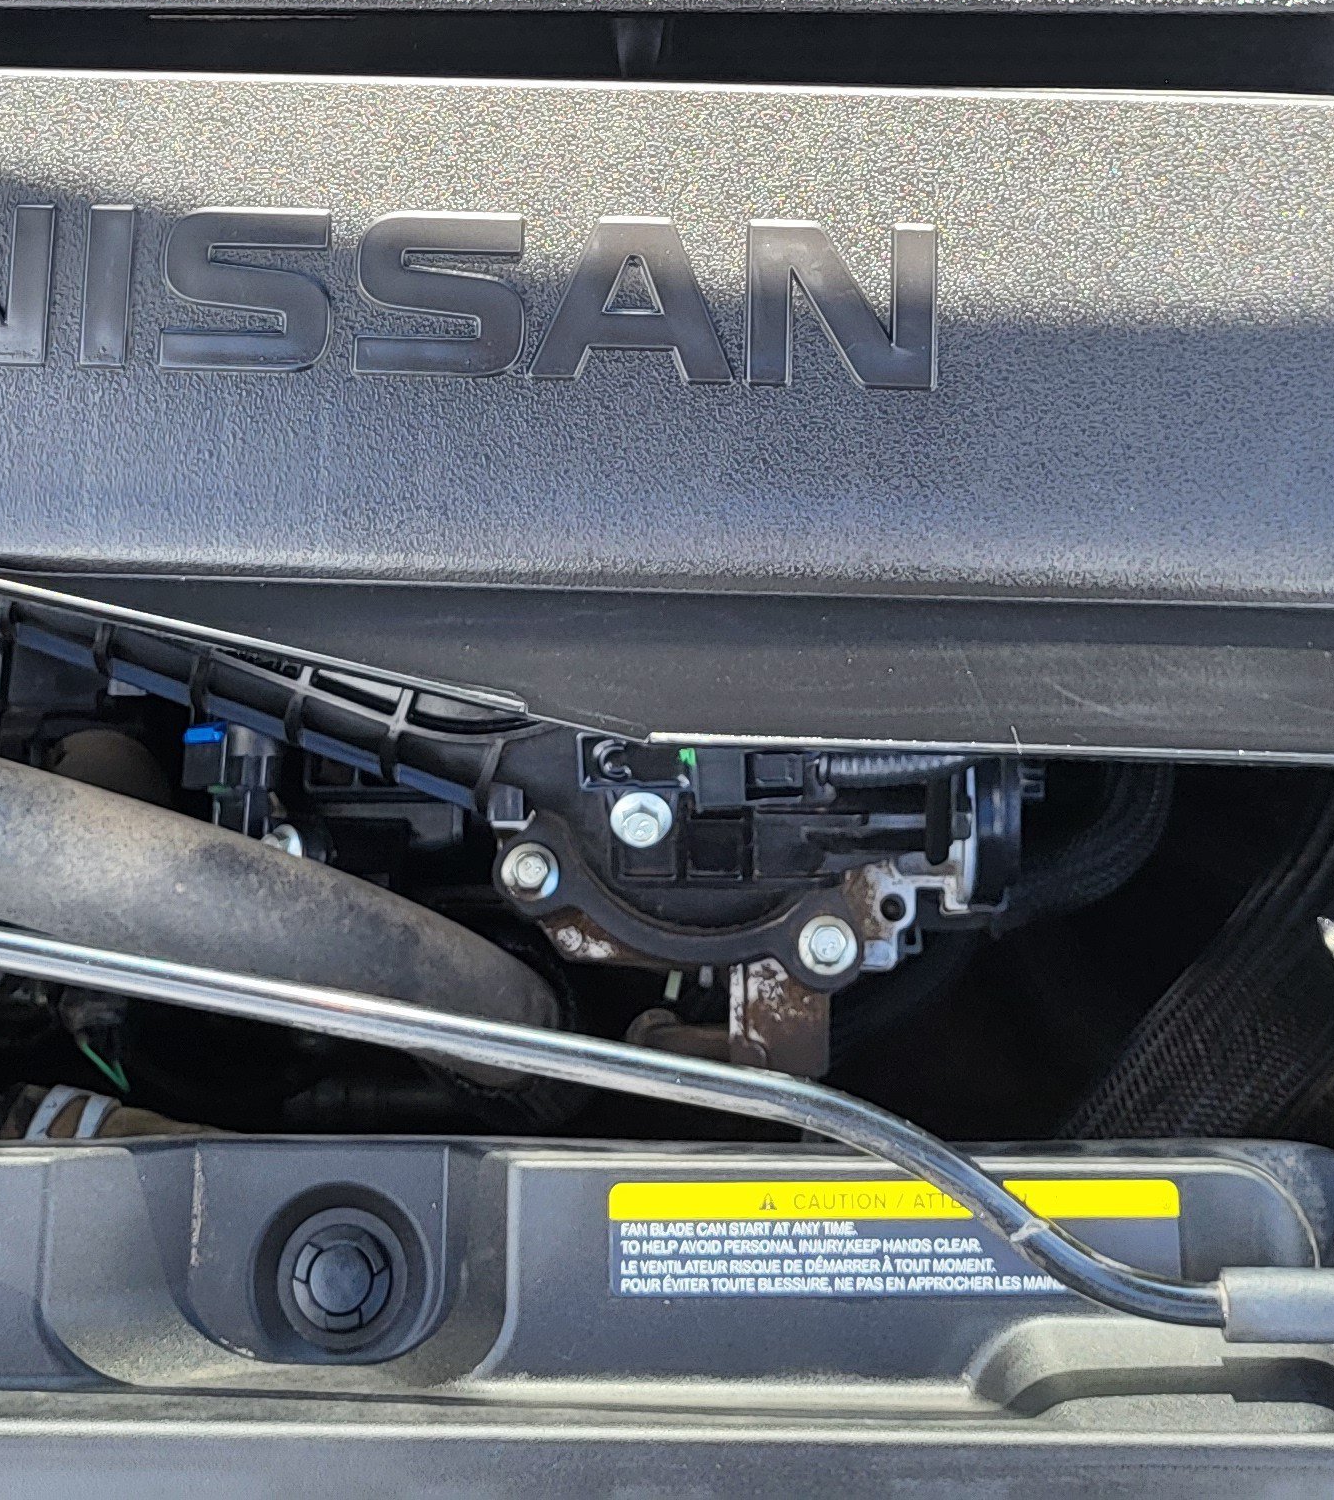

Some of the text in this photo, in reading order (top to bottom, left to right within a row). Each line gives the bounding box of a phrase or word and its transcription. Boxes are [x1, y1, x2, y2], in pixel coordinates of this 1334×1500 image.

[793, 1193, 886, 1210] CAUTION
[621, 1221, 858, 1237] FAN BLADE CAN START AT ANY TIME.
[621, 1238, 640, 1255] TO
[642, 1238, 678, 1255] HELP
[679, 1238, 722, 1255] AVOID
[723, 1238, 797, 1255] PERSONAL
[883, 1238, 931, 1255] HANDS
[933, 1238, 983, 1255] CLEAR.
[621, 1259, 638, 1274] LE
[640, 1259, 727, 1274] VENTILATEUR
[729, 1259, 781, 1274] RISQUE
[783, 1259, 802, 1274] DE
[805, 1256, 880, 1274] DÉMARRER
[895, 1258, 932, 1274] TOUT
[933, 1258, 997, 1274] MOMENT.
[621, 1277, 661, 1292] POUR
[663, 1275, 709, 1292] ÉVITER
[711, 1277, 755, 1292] TOUTE
[757, 1277, 832, 1292] BLESSURE,
[835, 1277, 854, 1292] NE
[856, 1277, 883, 1292] PAS
[885, 1277, 906, 1292] EN
[907, 1276, 994, 1292] APPROCHER
[996, 1275, 1022, 1292] LES
